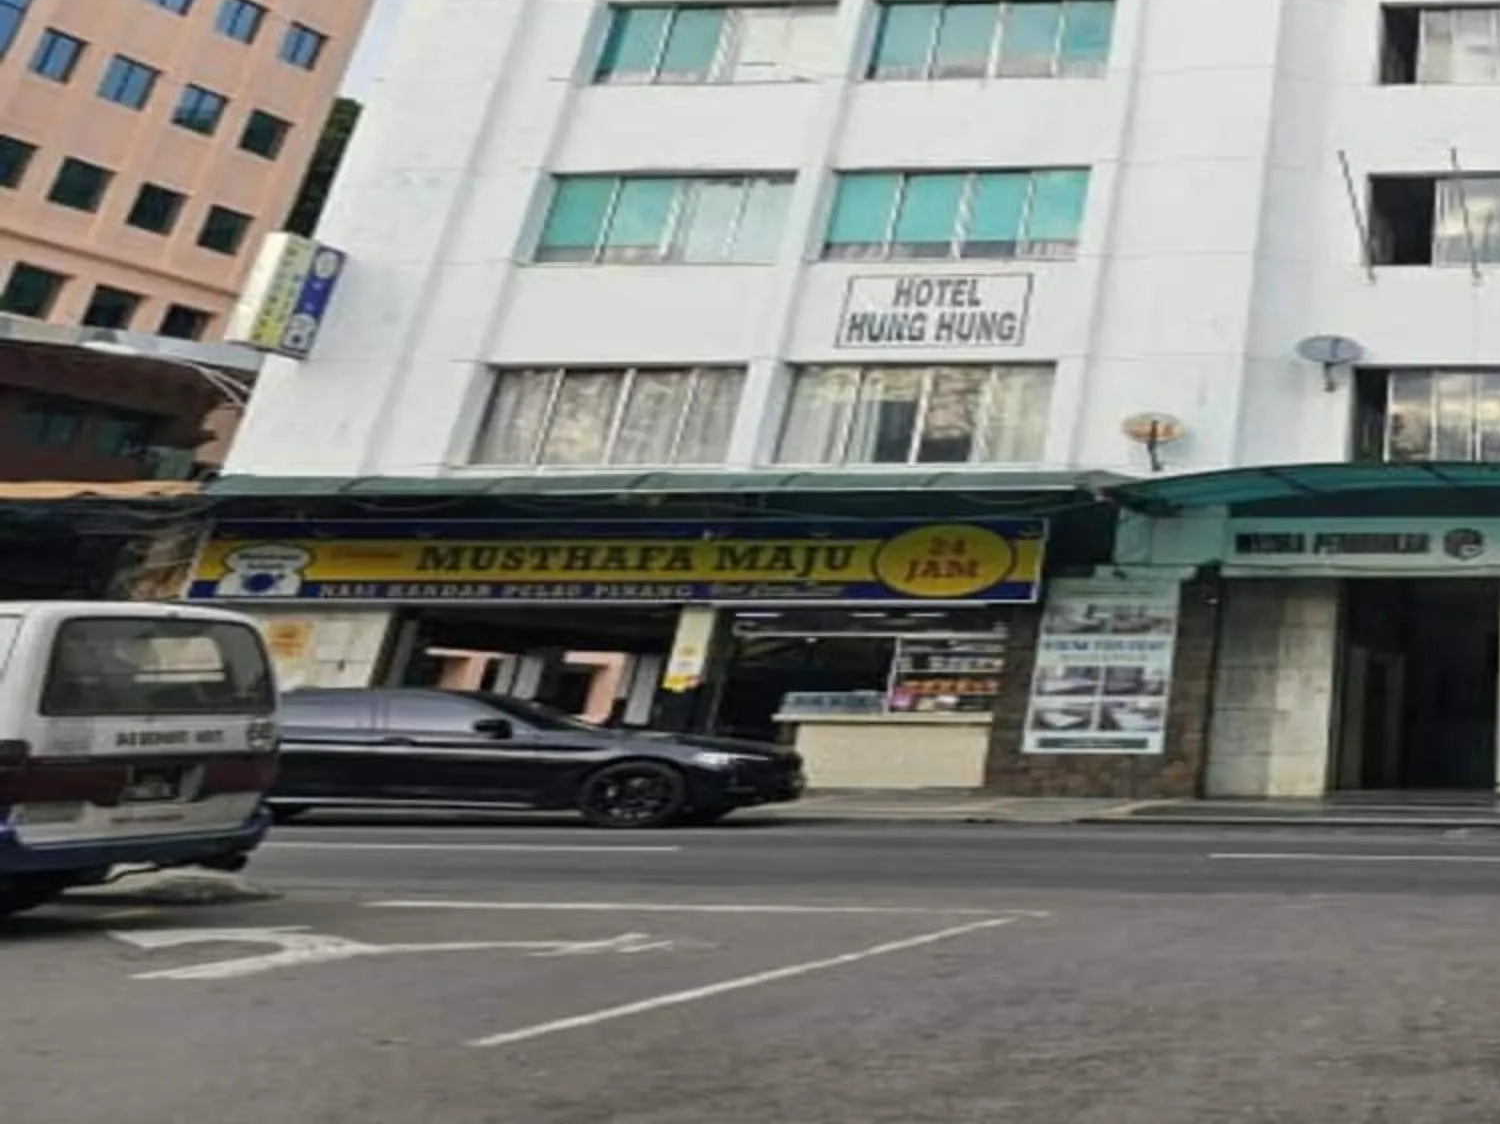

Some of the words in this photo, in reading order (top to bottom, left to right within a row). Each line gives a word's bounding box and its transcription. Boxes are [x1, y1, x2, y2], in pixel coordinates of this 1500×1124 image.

[893, 277, 982, 308] HOTEL
[846, 311, 928, 342] HUNG
[934, 311, 1018, 342] HUNG
[415, 545, 694, 572] MUSTHAFA
[711, 544, 857, 579] MAJU
[928, 536, 967, 556] 24
[904, 558, 979, 582] JAM
